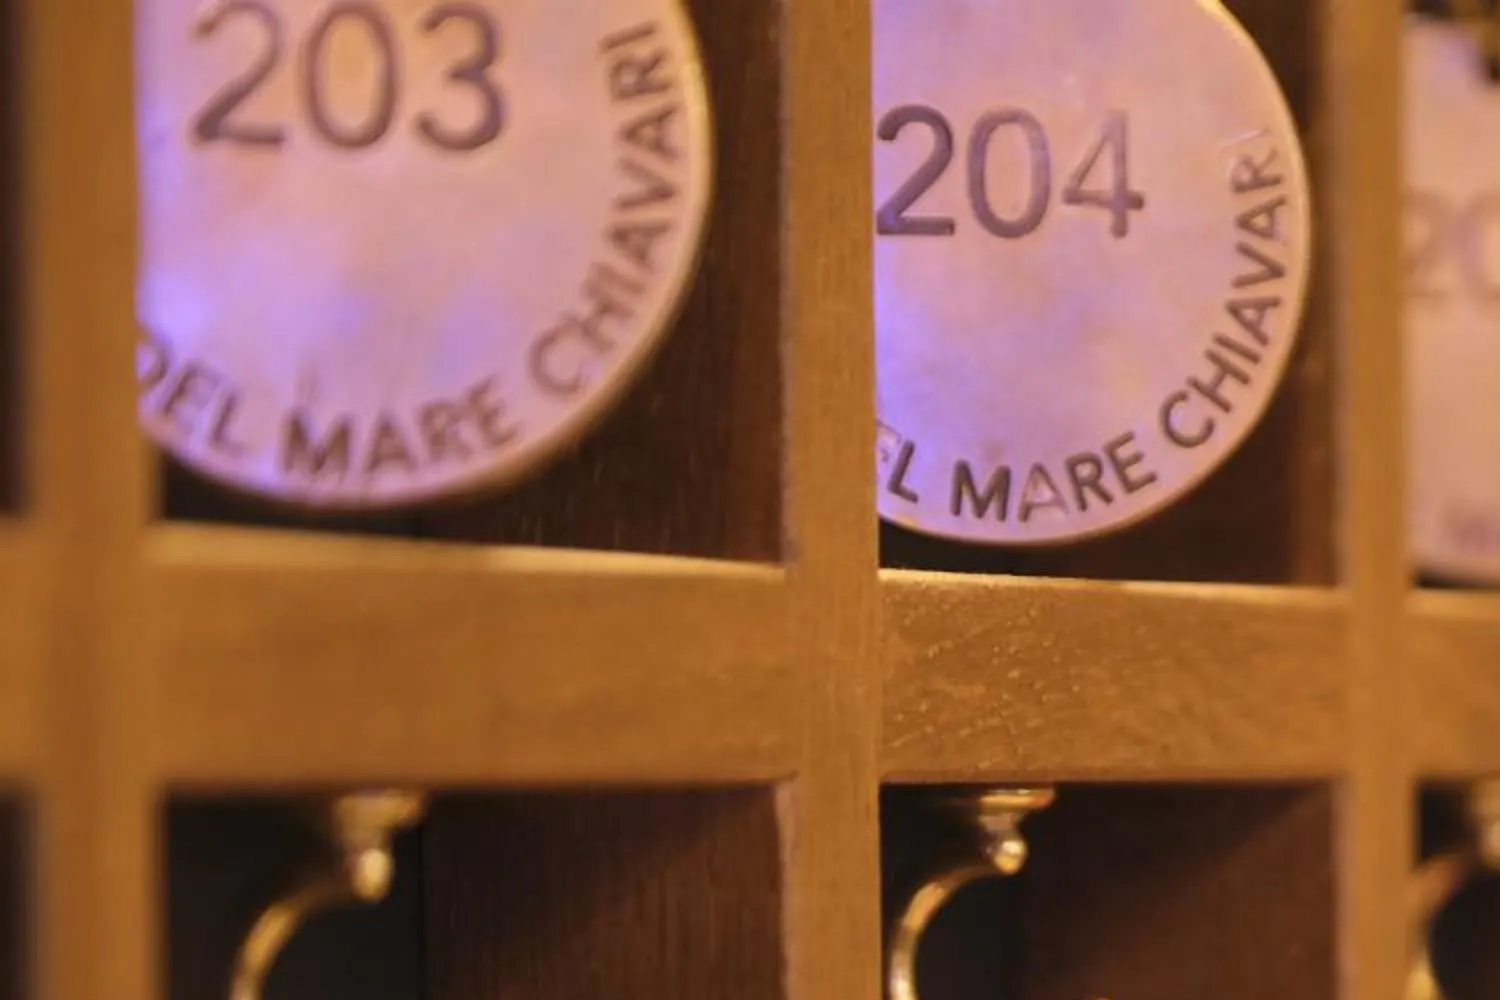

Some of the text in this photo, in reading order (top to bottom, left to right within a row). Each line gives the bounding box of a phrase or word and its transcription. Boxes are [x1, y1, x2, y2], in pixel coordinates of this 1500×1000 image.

[186, 0, 508, 152] 203
[875, 104, 1146, 240] 204
[279, 372, 526, 484] MARE
[525, 18, 683, 404] CHIAVARI
[949, 430, 1158, 524] MARE
[1158, 126, 1289, 450] CHIAVARI
